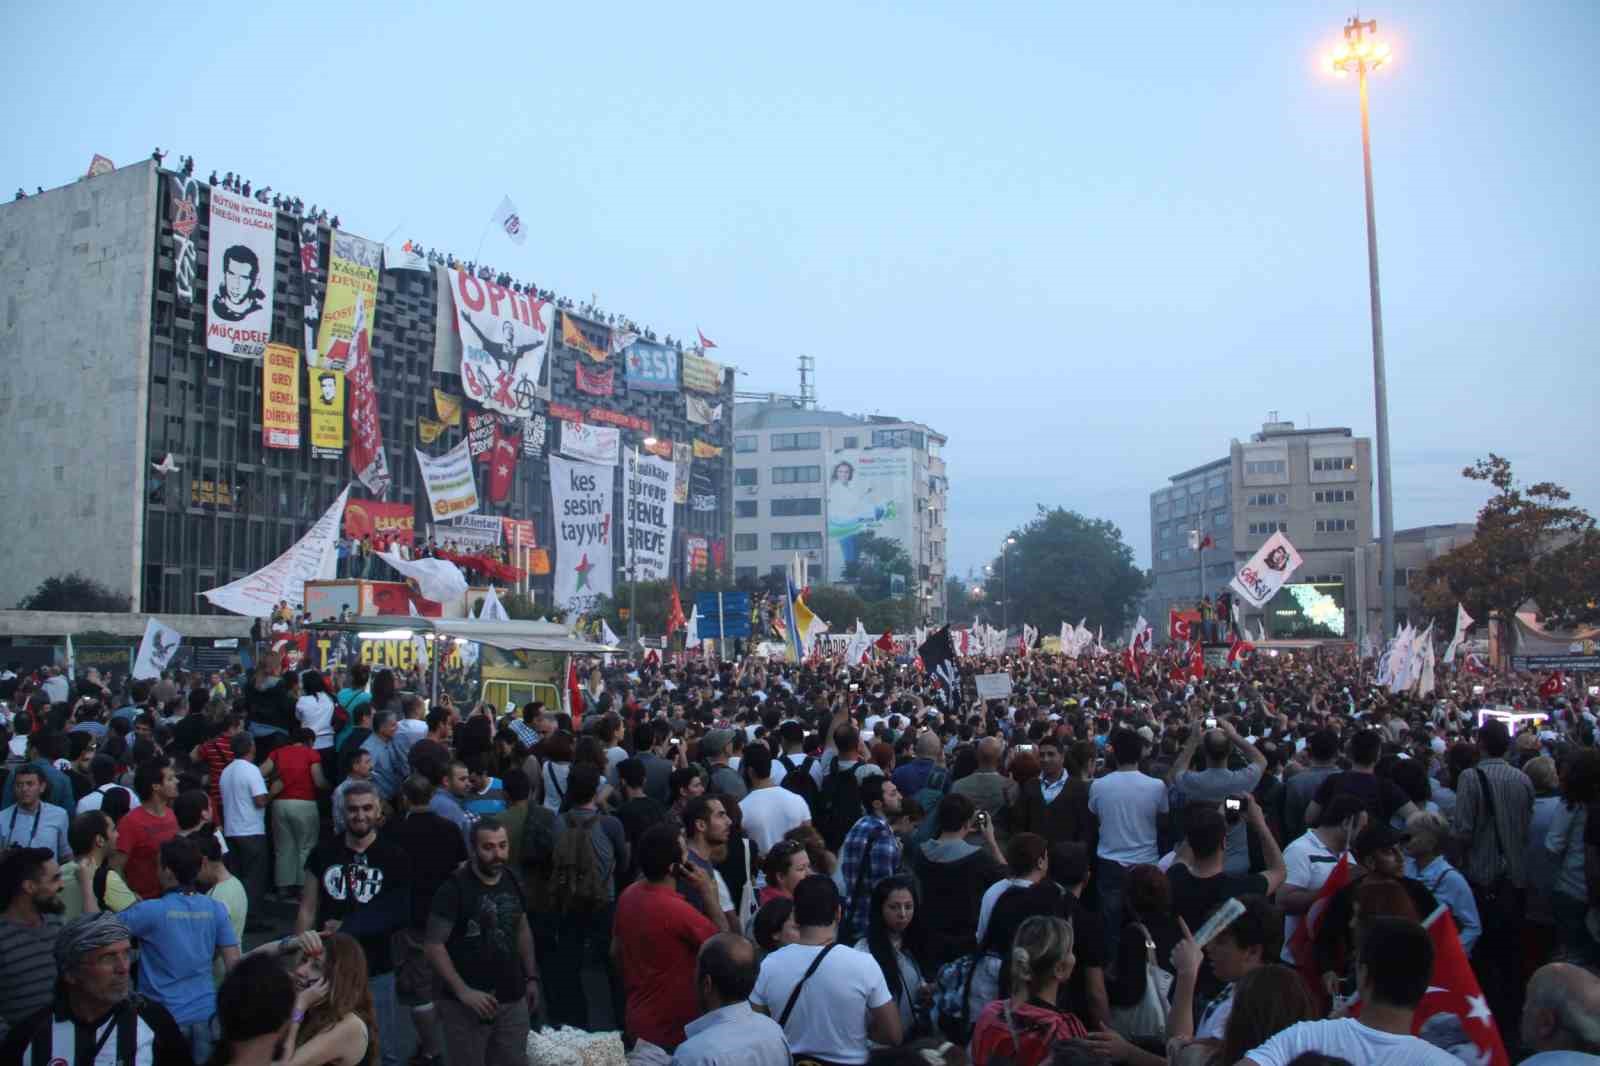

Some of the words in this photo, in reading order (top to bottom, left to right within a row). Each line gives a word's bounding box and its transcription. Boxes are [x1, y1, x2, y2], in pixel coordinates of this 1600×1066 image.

[208, 323, 269, 344] MÜCADELE
[270, 353, 294, 368] GENEL
[570, 468, 596, 492] kes
